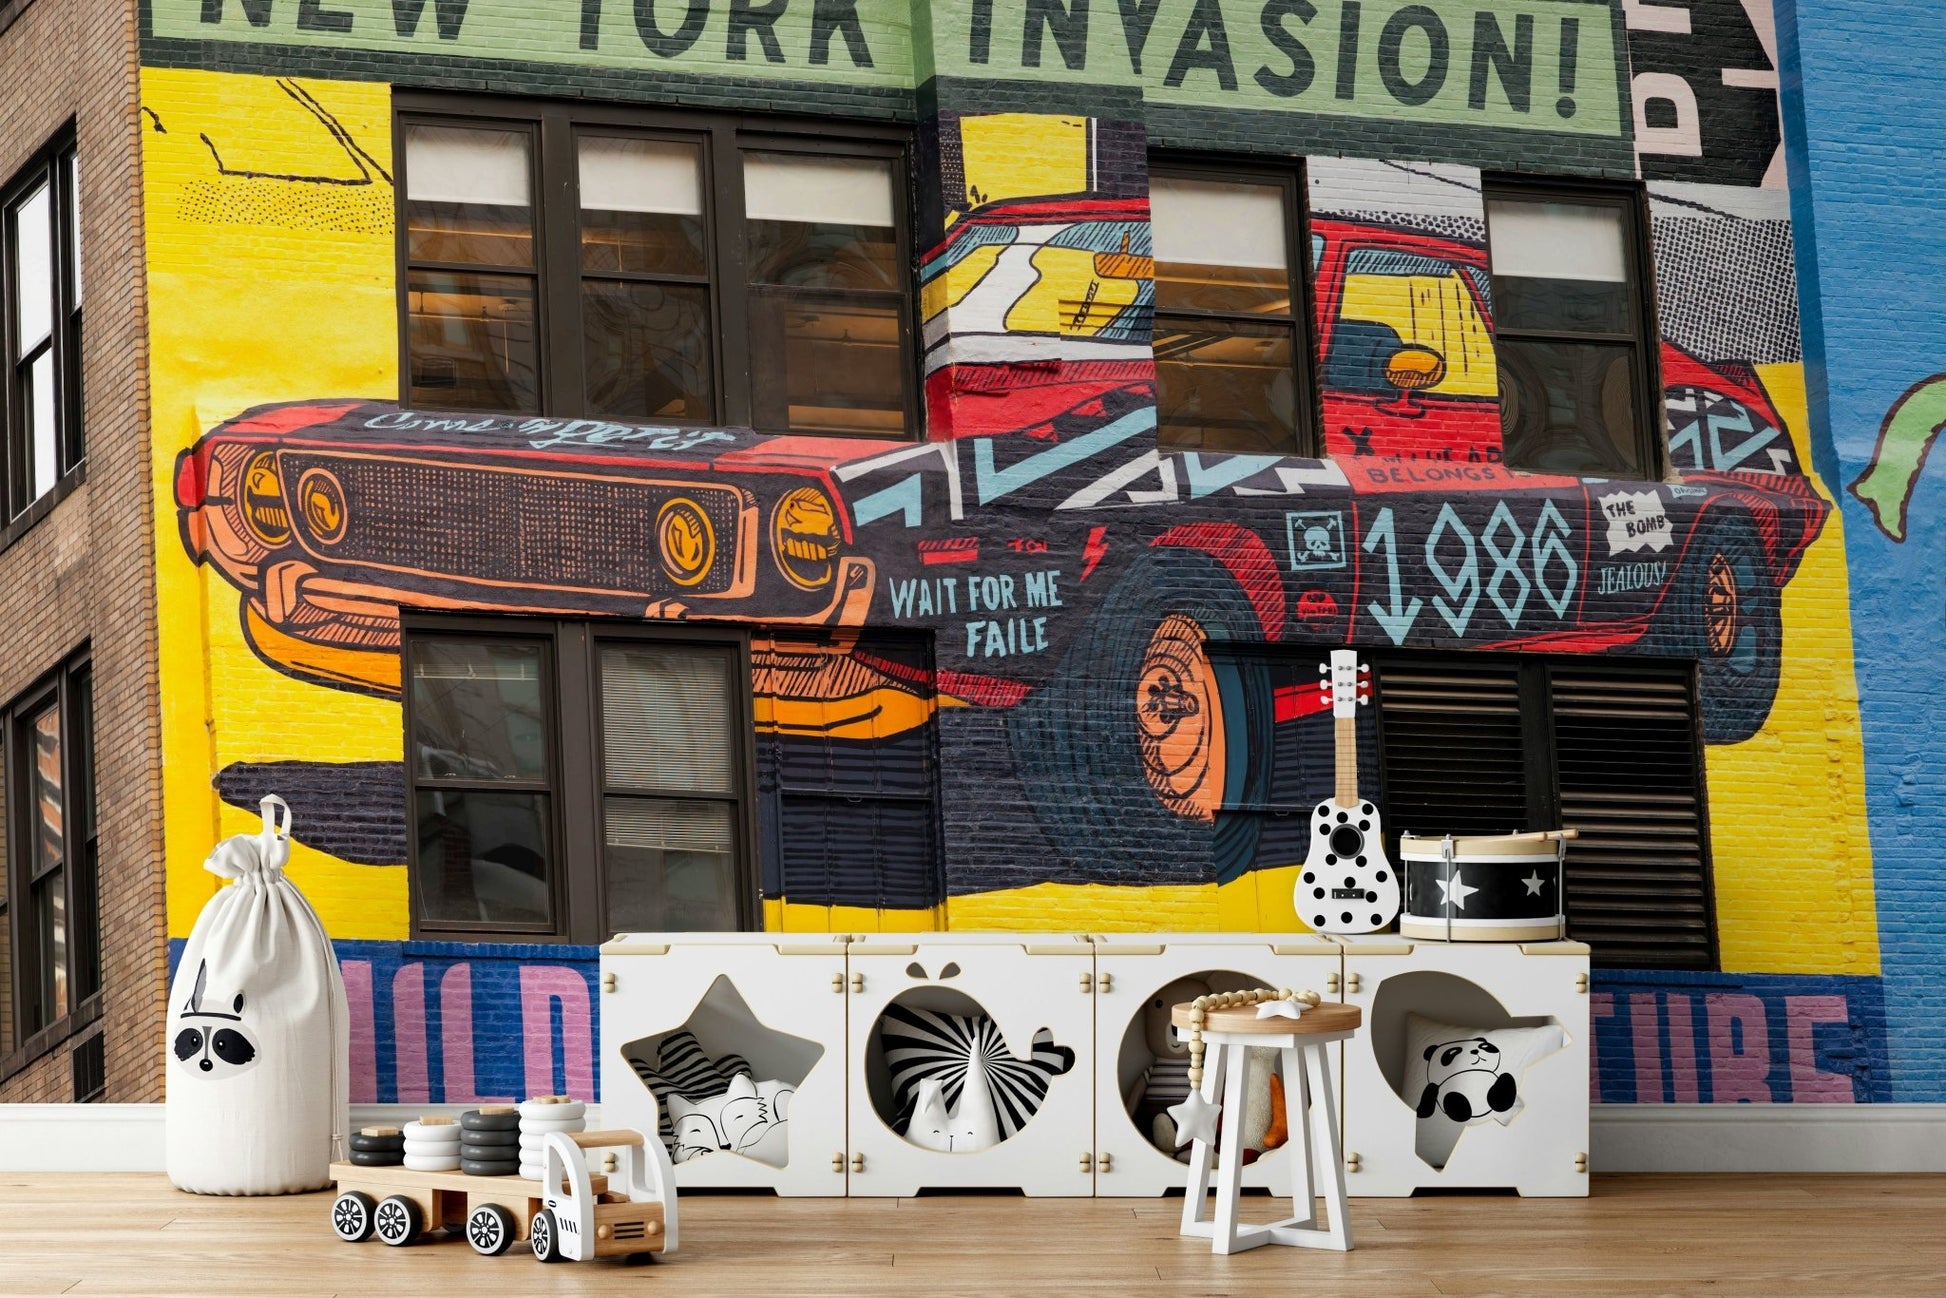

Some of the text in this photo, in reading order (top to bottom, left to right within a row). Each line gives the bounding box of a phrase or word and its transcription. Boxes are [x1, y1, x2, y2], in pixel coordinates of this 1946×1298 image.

[968, 0, 1581, 119] INVASION!
[1366, 466, 1496, 484] BELONGS
[1606, 500, 1636, 518] THE
[1625, 515, 1666, 538] BOMB
[1361, 497, 1578, 646] 1986
[1597, 560, 1667, 595] JEALOUS!
[889, 570, 1063, 619] WAIT FOR ME
[965, 616, 1049, 658] FAILE
